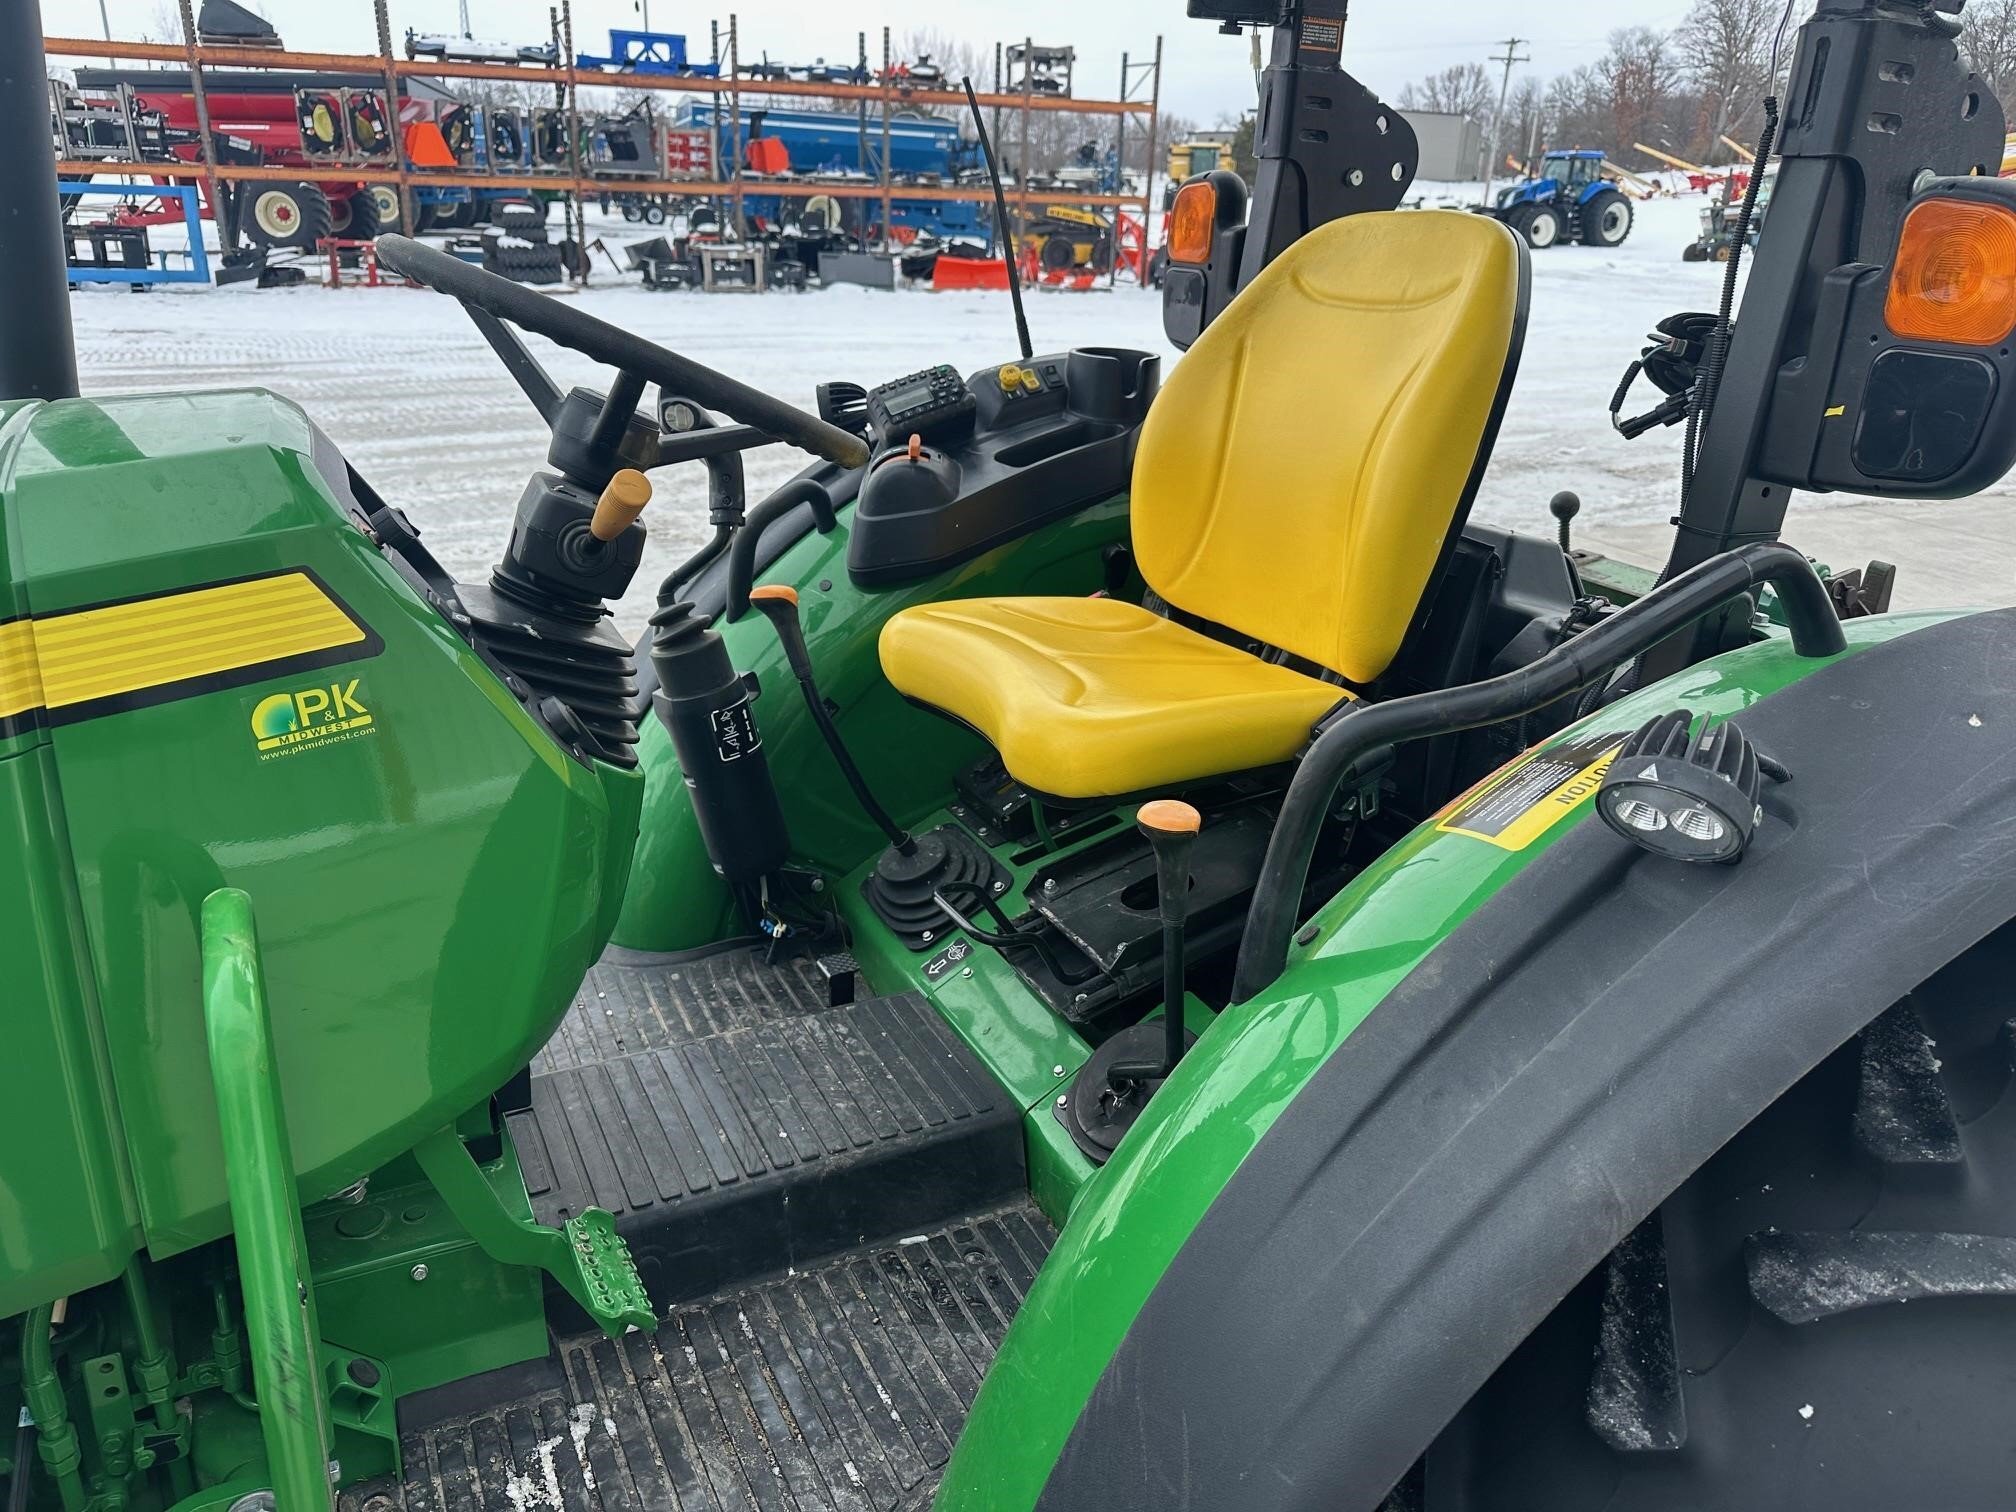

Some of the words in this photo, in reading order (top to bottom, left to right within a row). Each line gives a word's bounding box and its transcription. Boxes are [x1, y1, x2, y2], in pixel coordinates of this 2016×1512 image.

[260, 726, 376, 761] www.pkmidwest.com
[279, 720, 353, 745] MIDWEST
[1555, 760, 1613, 805] UTION
